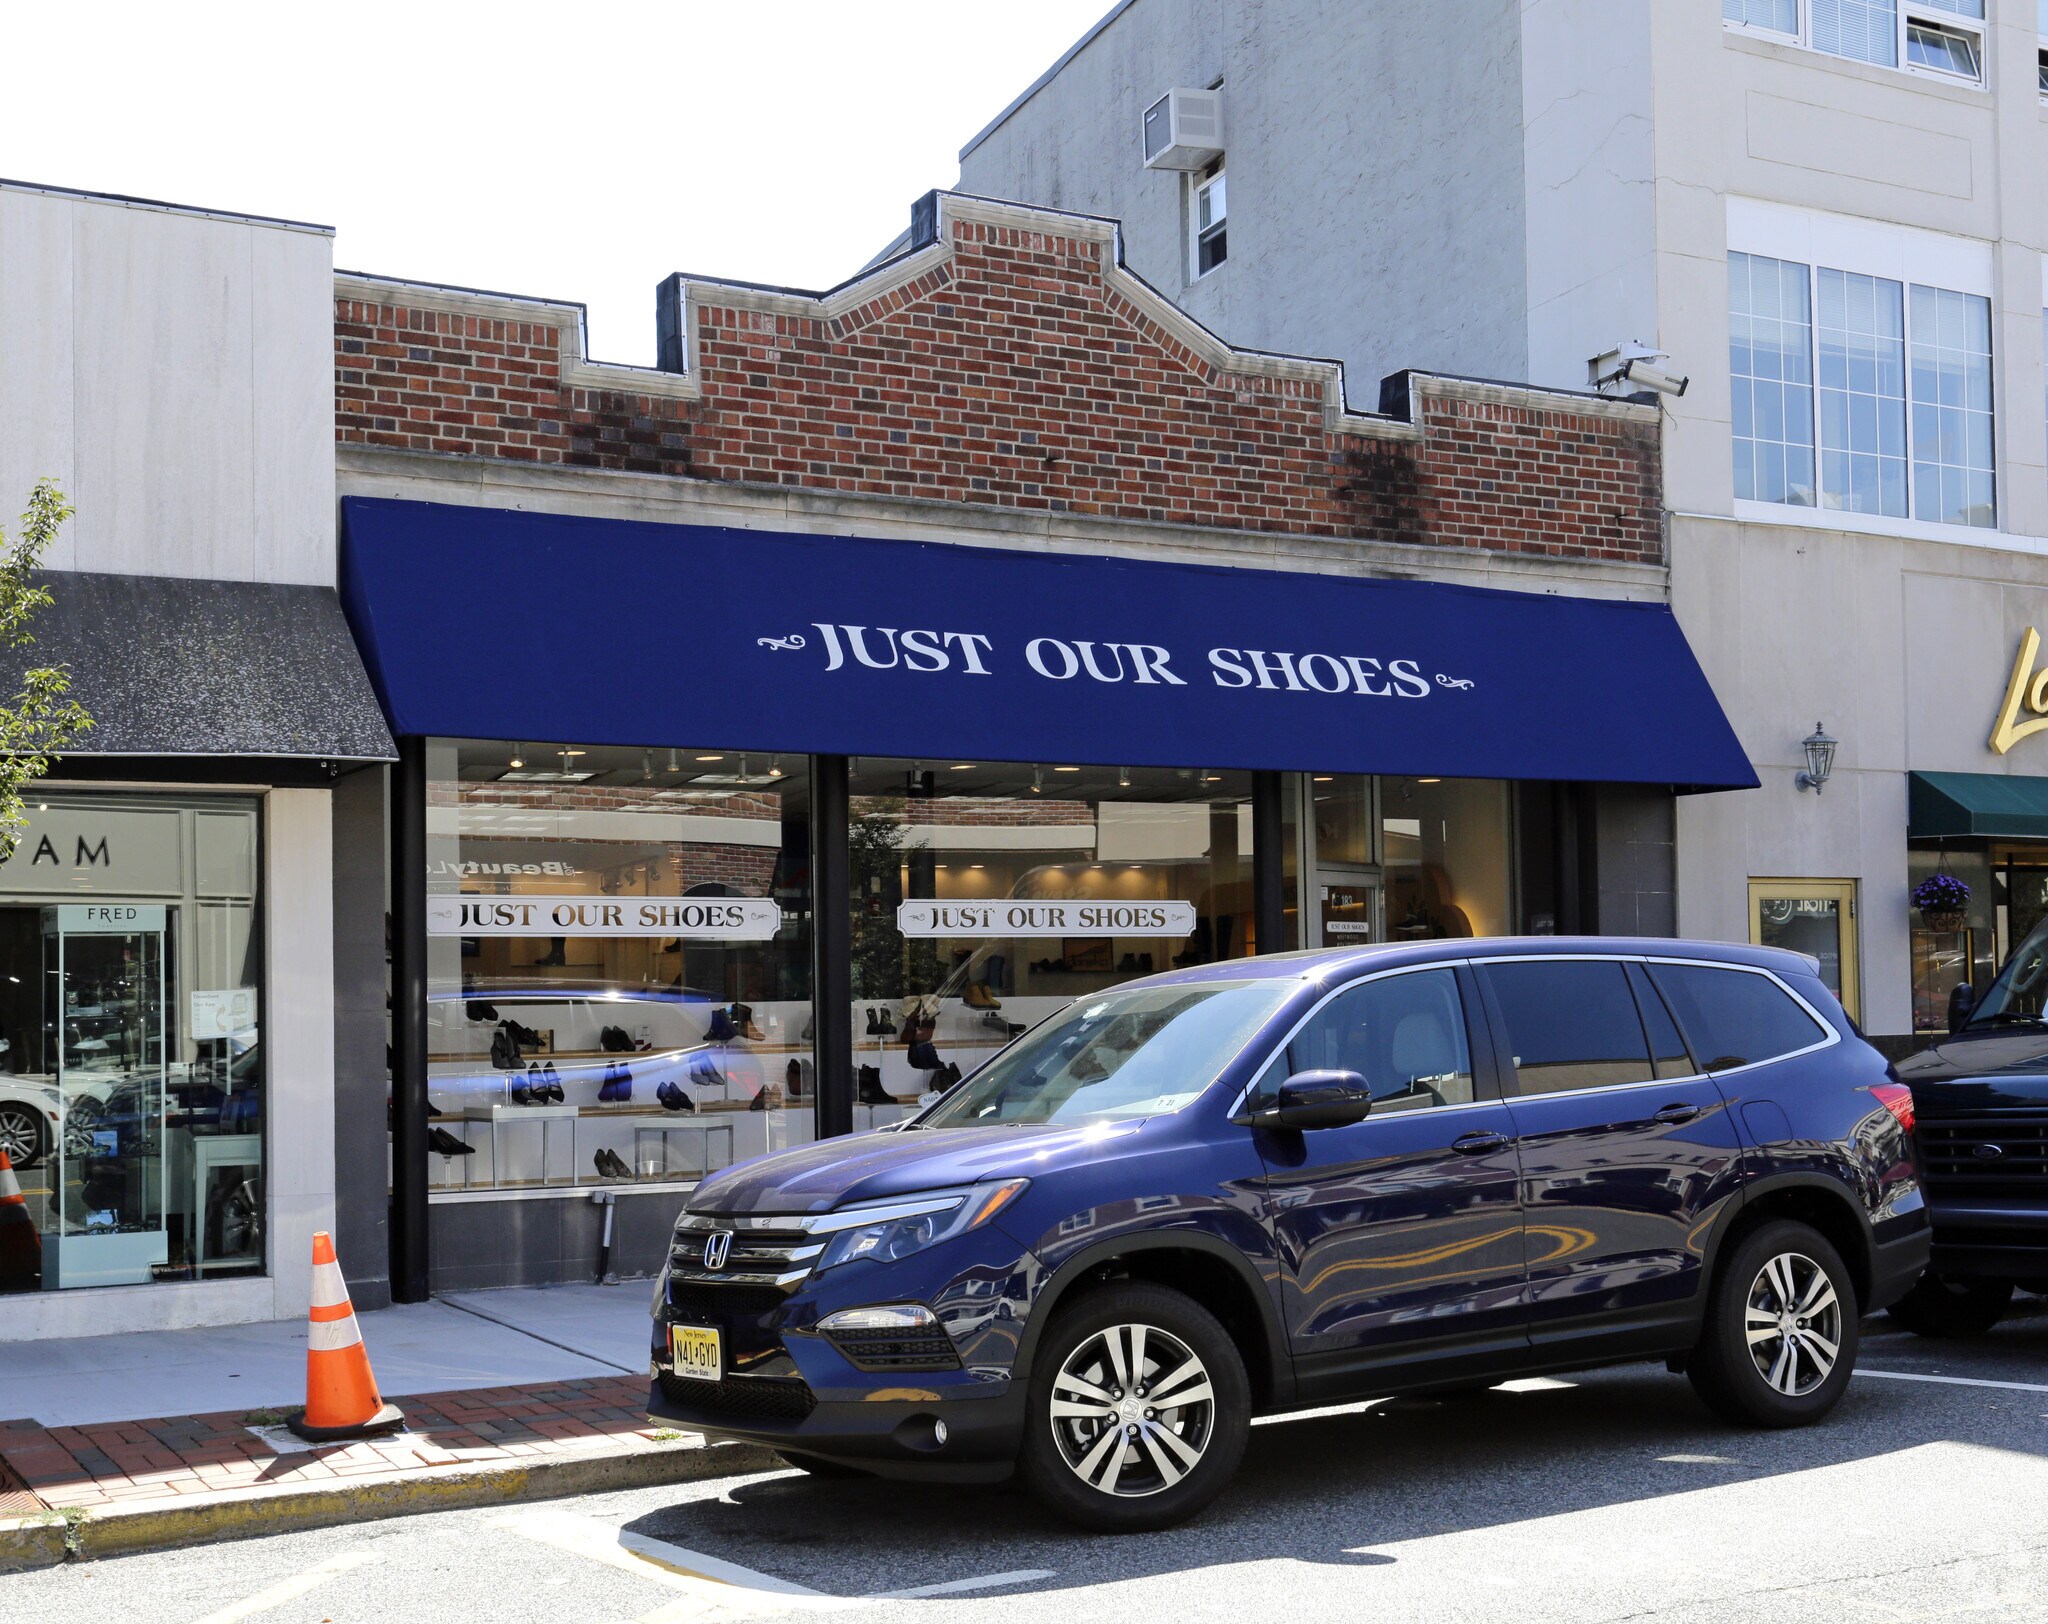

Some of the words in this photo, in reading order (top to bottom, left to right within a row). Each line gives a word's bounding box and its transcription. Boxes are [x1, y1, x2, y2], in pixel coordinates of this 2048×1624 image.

[811, 623, 993, 675] JUST
[1026, 638, 1188, 685] OUR
[1208, 648, 1431, 698] SHOES
[88, 908, 137, 922] FRED
[460, 904, 537, 928] JUST
[552, 904, 624, 928] OUR
[639, 905, 745, 928] SHOES
[930, 907, 996, 929] JUST
[1007, 907, 1066, 928] OUR
[1079, 908, 1166, 928] SHOES
